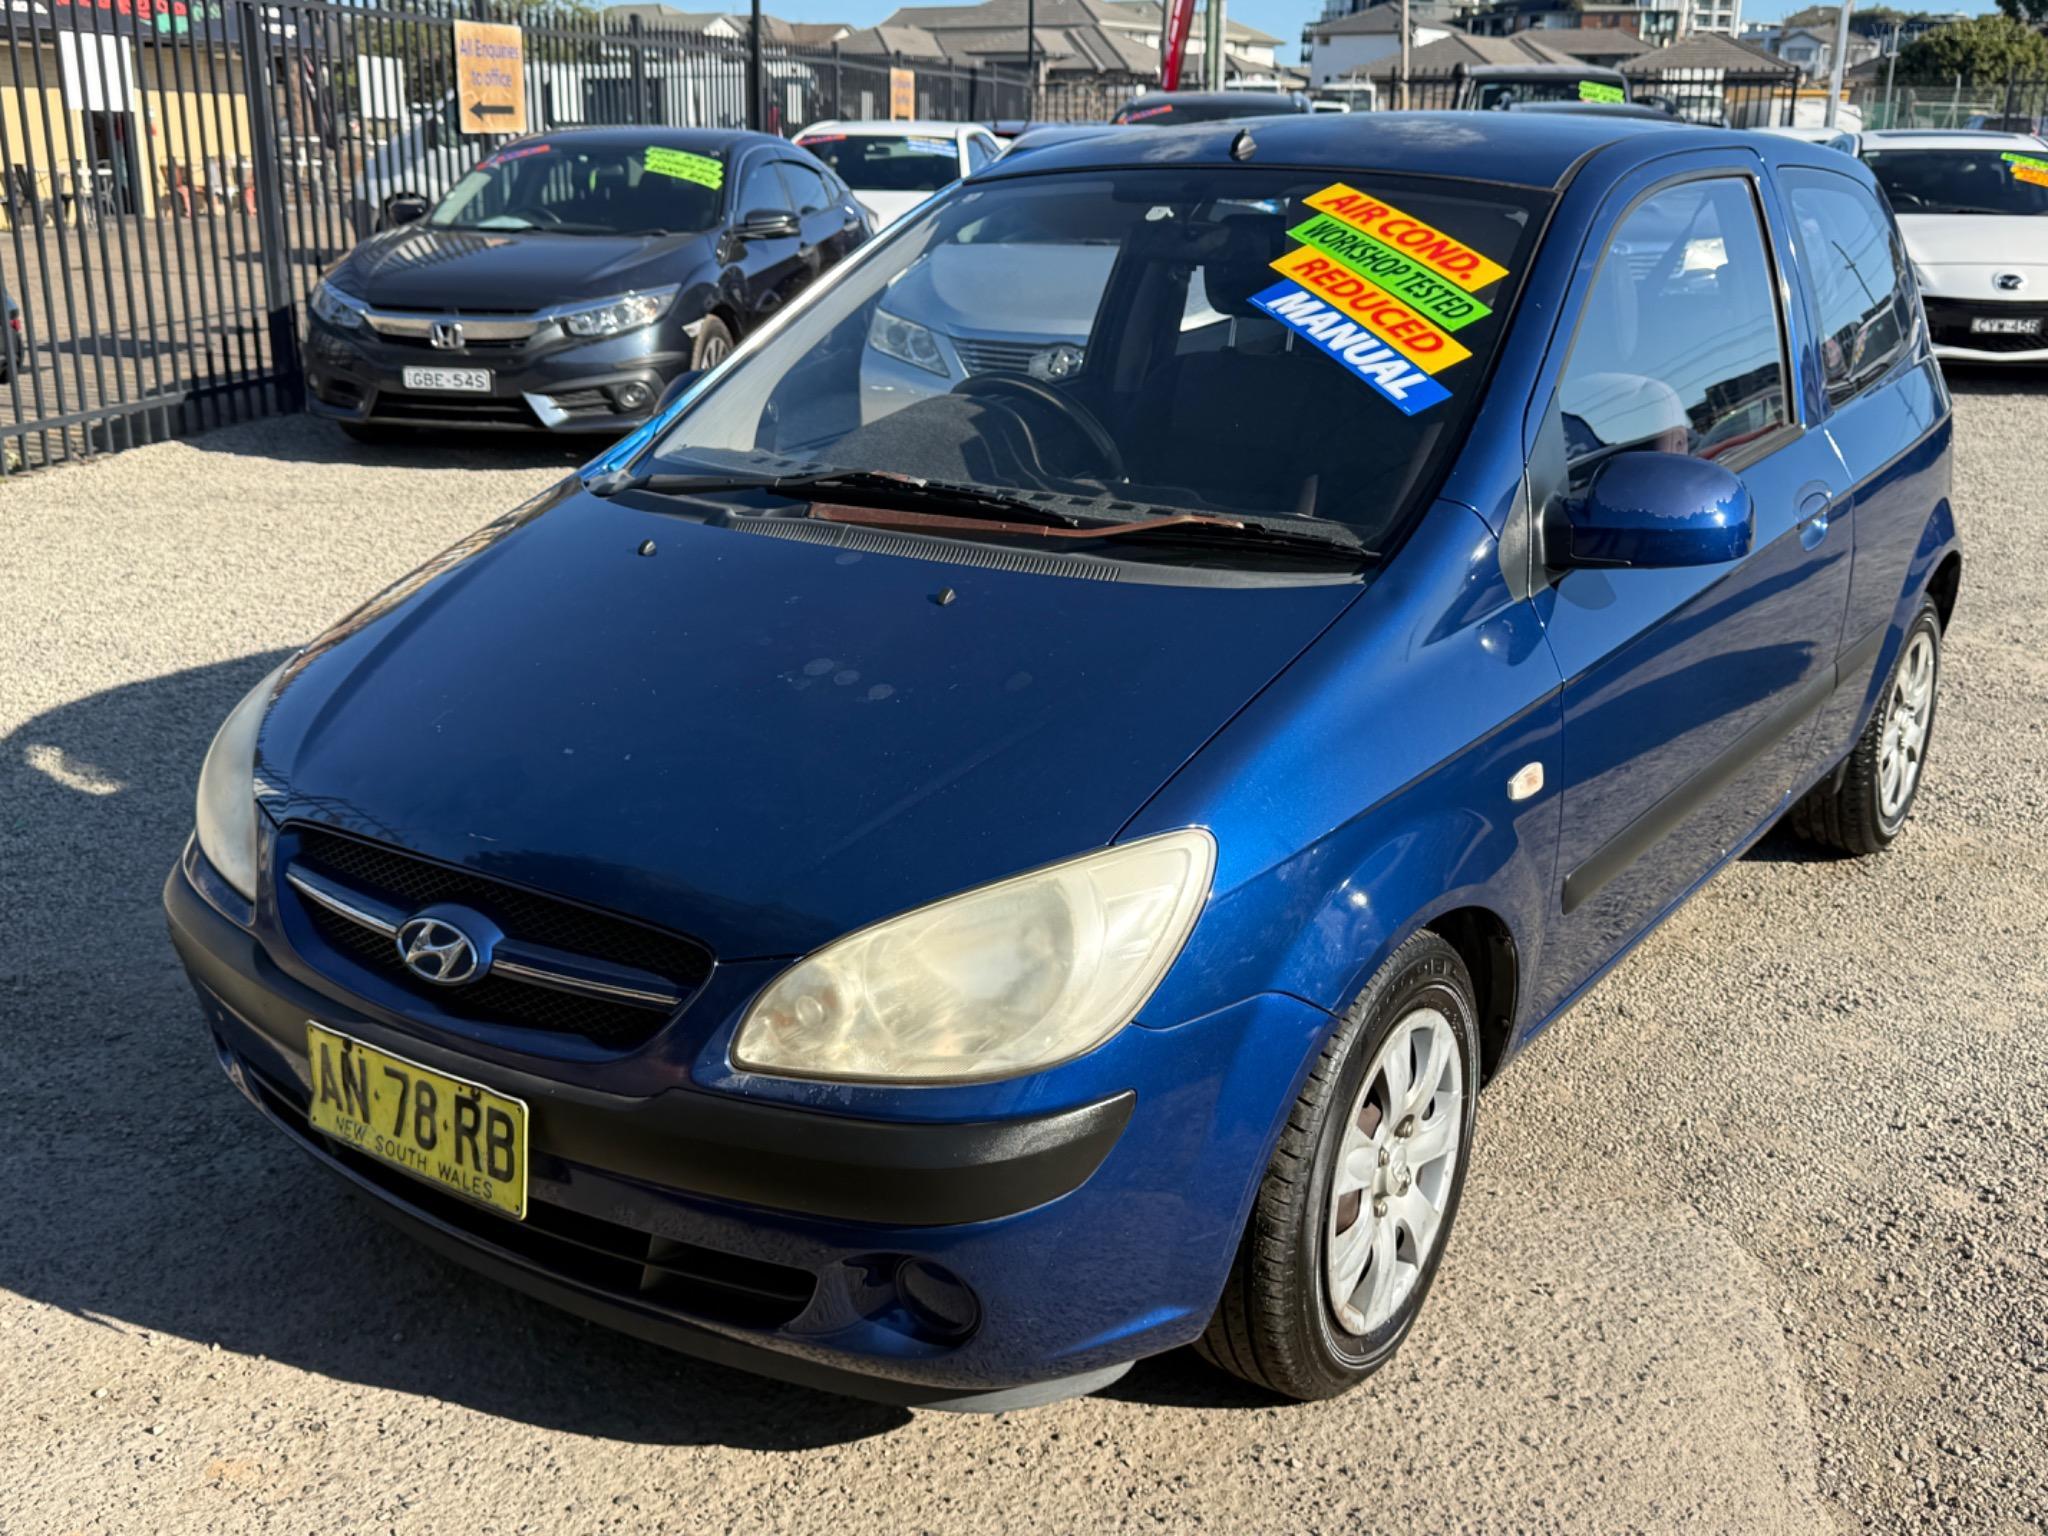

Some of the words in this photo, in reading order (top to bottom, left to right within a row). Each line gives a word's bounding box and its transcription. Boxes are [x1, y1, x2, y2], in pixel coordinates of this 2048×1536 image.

[460, 38, 473, 57] All
[475, 39, 519, 62] Enquiries
[471, 70, 482, 86] to
[484, 68, 513, 88] office
[1304, 219, 1409, 278] WORKSHOP
[1396, 271, 1474, 319] TESTED
[1320, 194, 1389, 226] AIR
[1378, 219, 1480, 280] COND.
[1266, 290, 1428, 401] MANUAL
[1291, 257, 1444, 354] REDUCED
[335, 1115, 367, 1142] NEW
[375, 1135, 428, 1172] SOUTH
[438, 1161, 493, 1200] WALES
